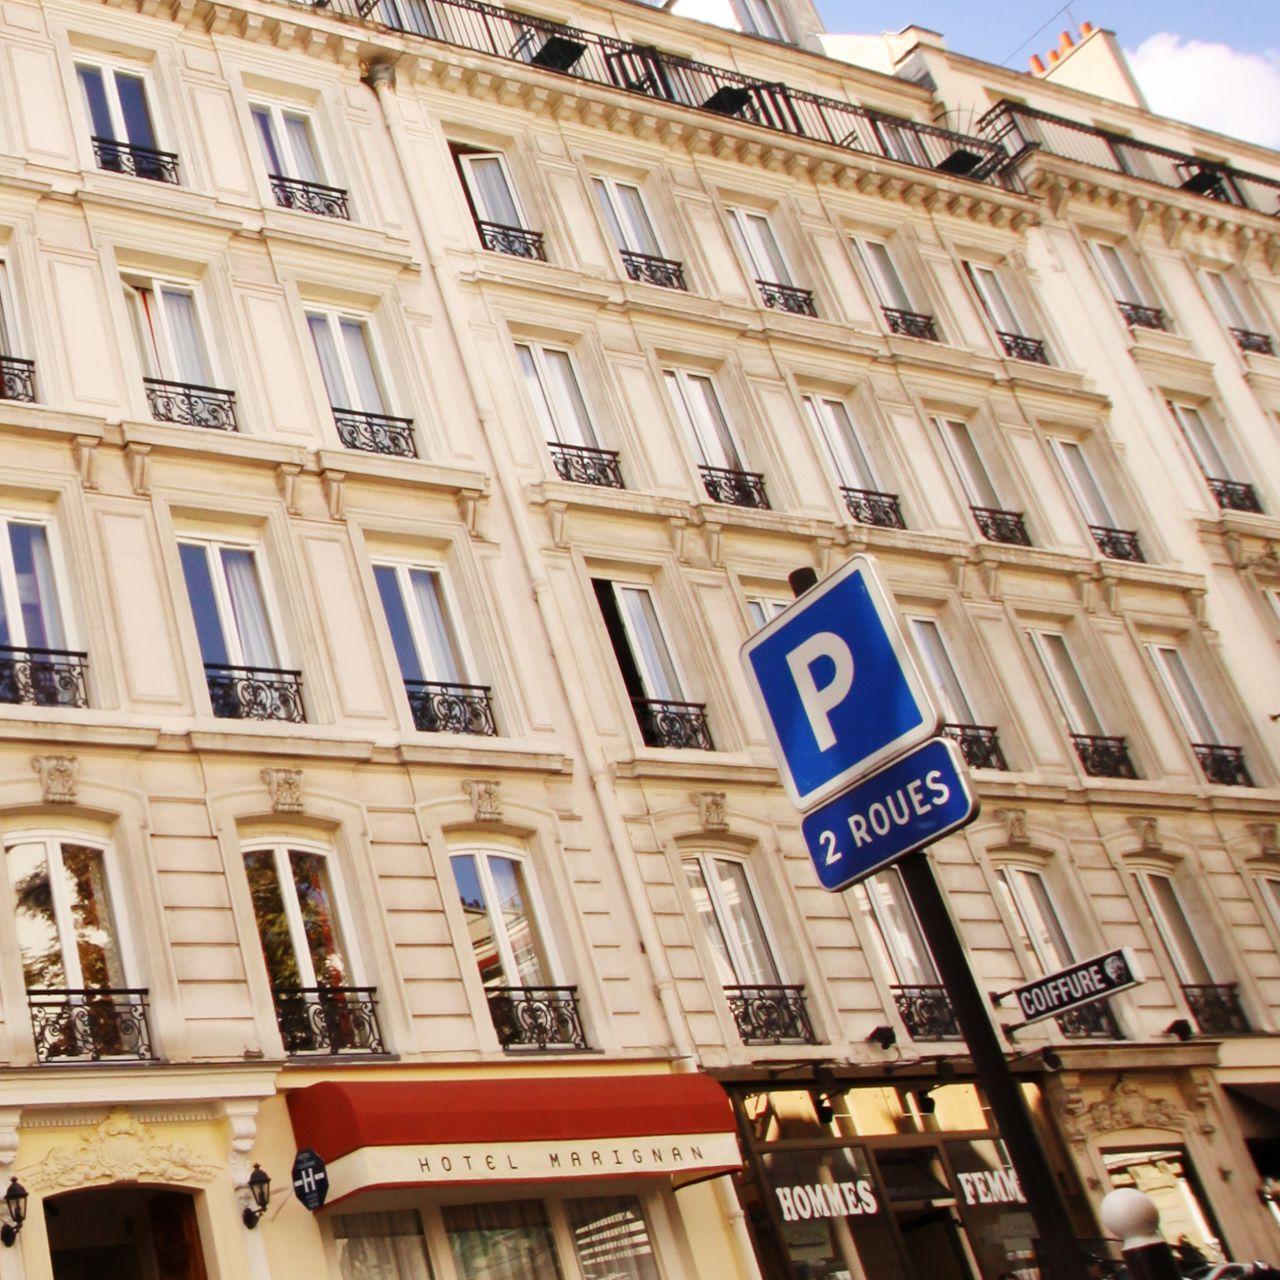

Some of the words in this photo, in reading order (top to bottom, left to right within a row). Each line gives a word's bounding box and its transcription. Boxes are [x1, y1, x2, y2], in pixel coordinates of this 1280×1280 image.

[786, 631, 855, 753] P
[819, 830, 843, 866] 2
[847, 770, 950, 848] ROUES
[1021, 966, 1106, 1015] COIFFURE
[419, 1155, 518, 1172] HOTEL
[549, 1146, 703, 1168] MARIGNAN
[776, 1180, 879, 1220] HOMMES
